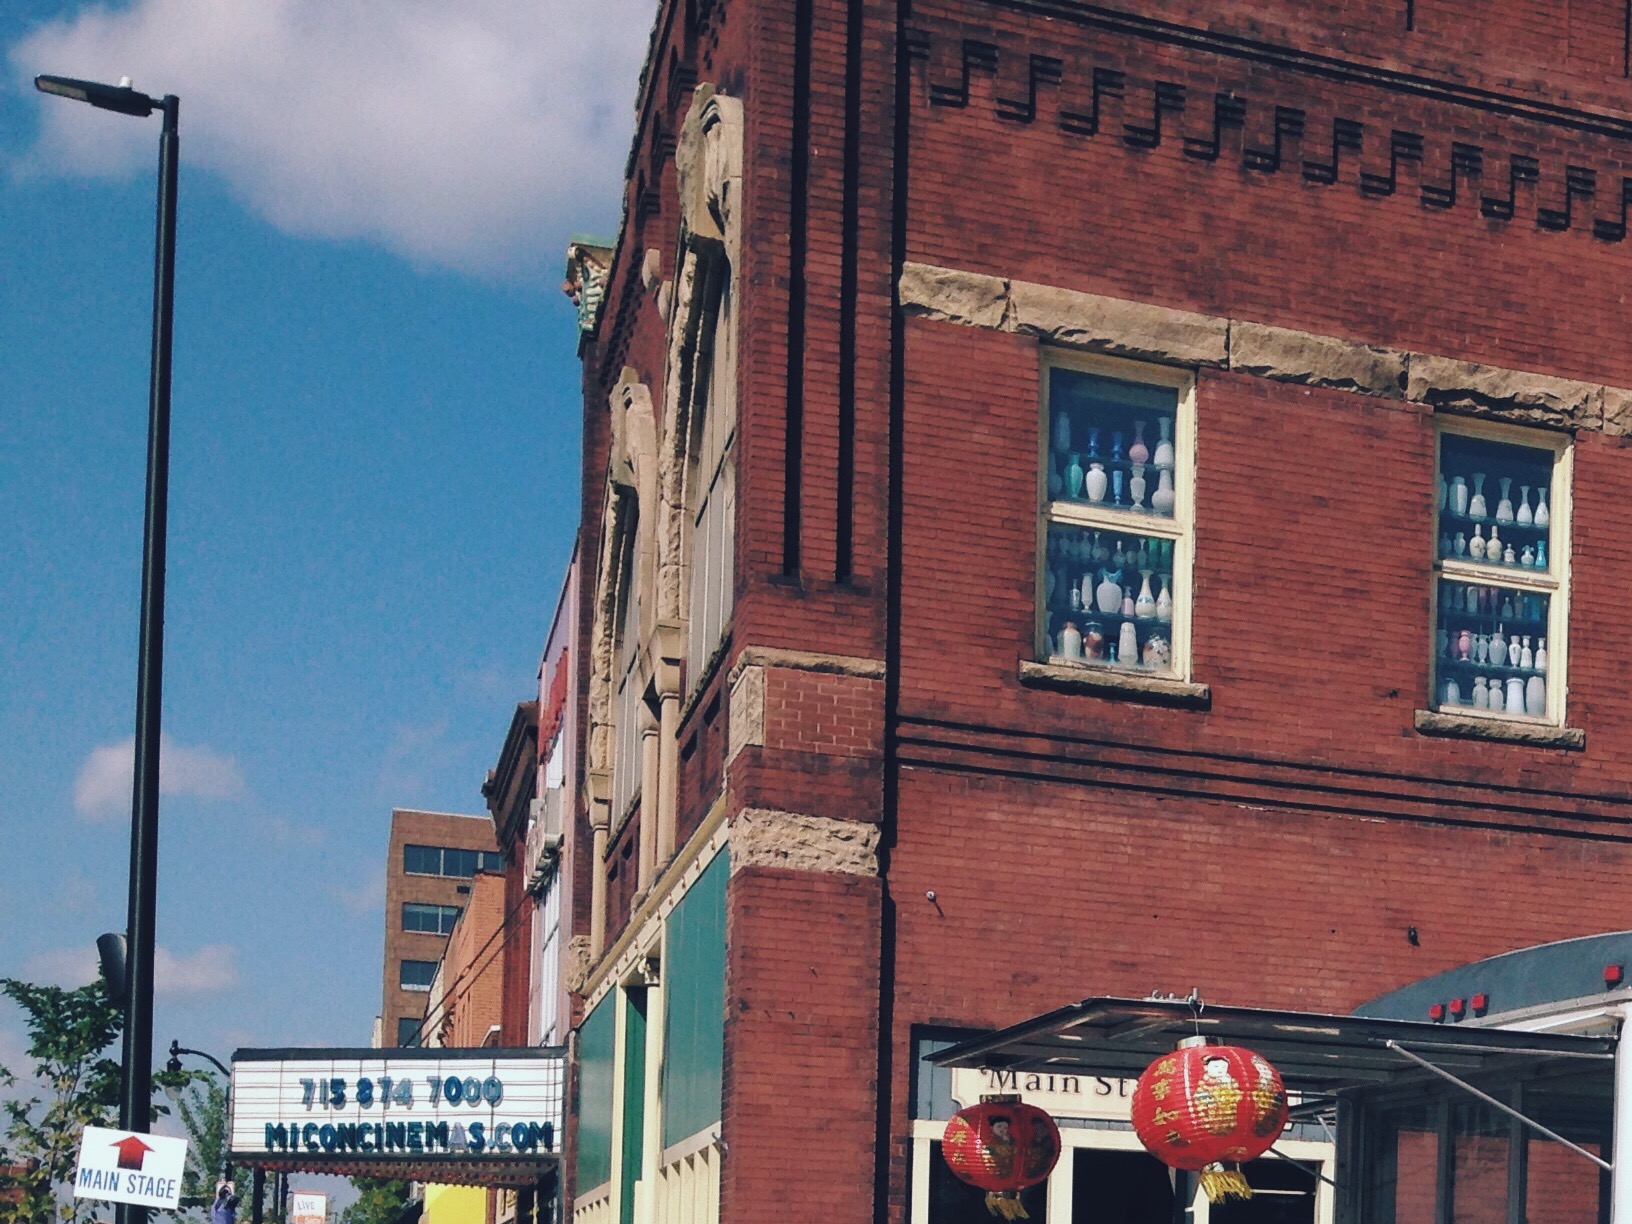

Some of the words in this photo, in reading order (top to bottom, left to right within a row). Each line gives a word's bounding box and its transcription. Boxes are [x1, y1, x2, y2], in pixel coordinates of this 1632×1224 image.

[299, 1078, 347, 1111] 715
[356, 1076, 415, 1110] 874
[427, 1075, 504, 1108] 7000
[264, 1120, 555, 1152] MICONCINEMAS.COM
[78, 1167, 120, 1192] MAIN
[126, 1173, 177, 1200] STAGE
